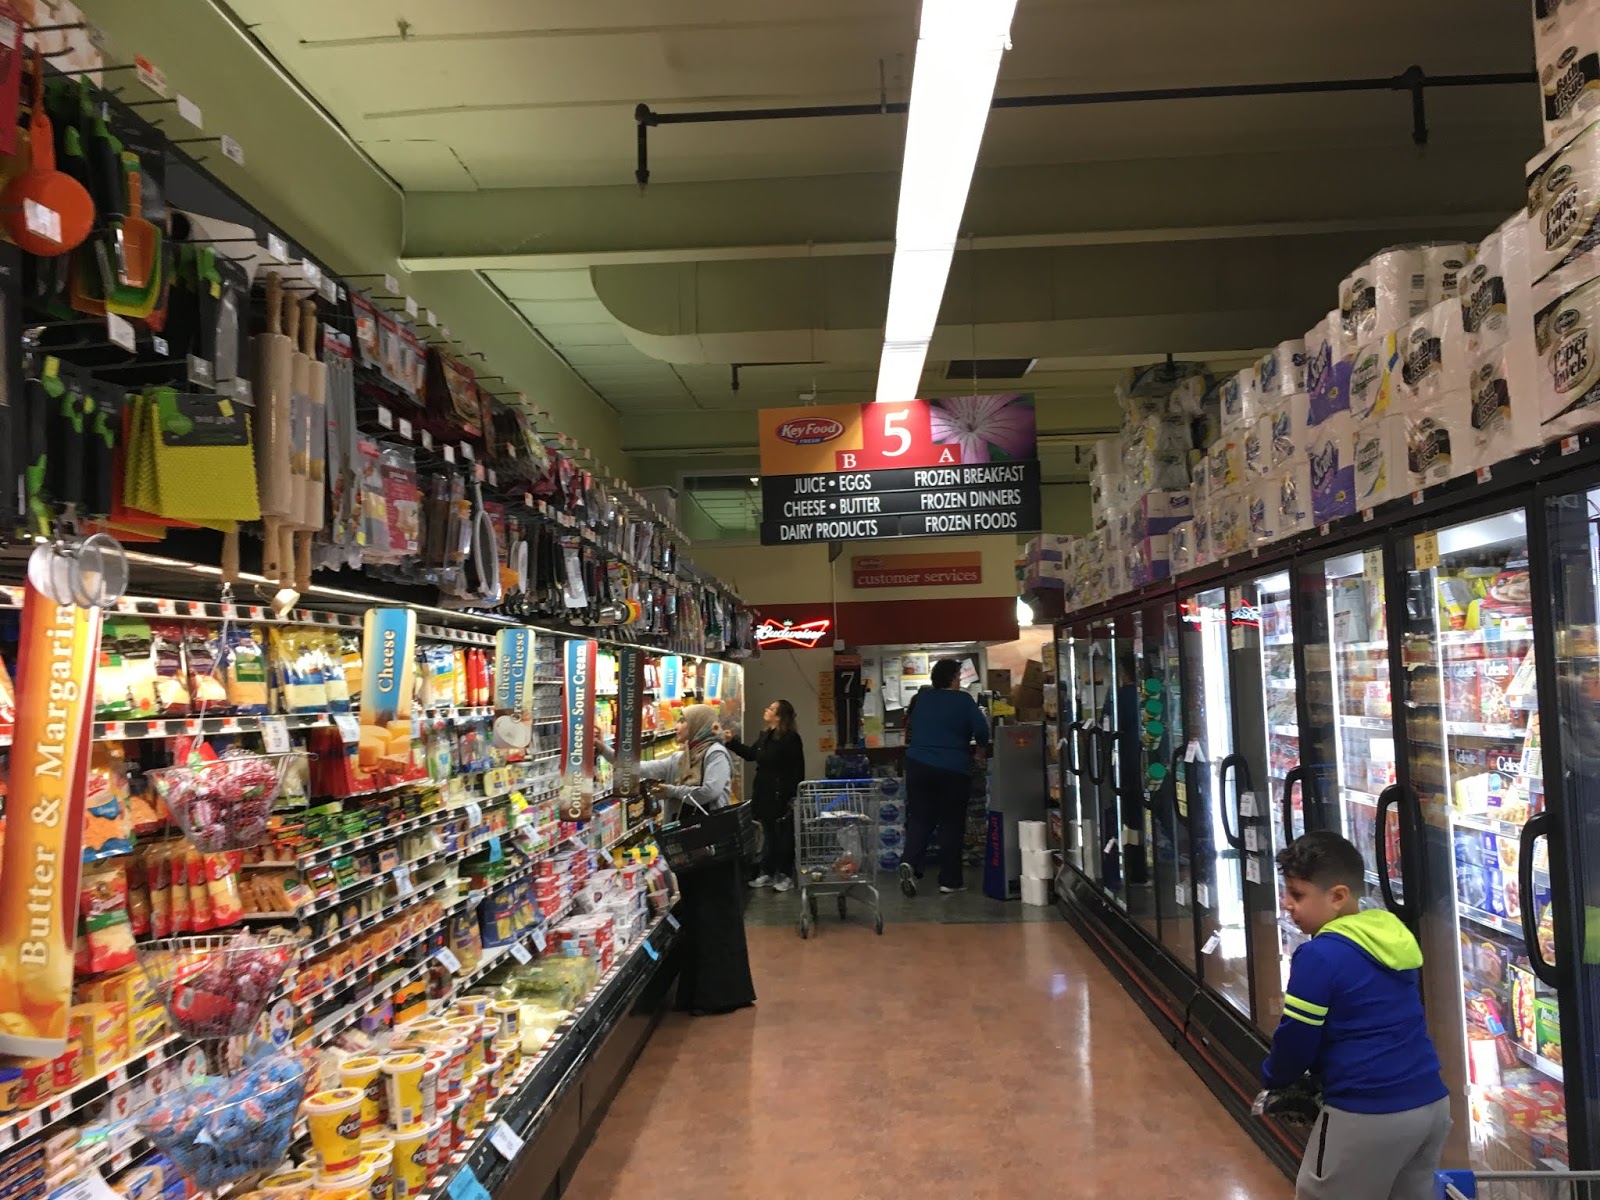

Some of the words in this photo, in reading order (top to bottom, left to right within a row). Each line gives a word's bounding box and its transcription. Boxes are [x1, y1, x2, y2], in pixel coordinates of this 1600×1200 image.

[1554, 333, 1588, 372] Paper
[781, 422, 803, 437] Key
[804, 422, 837, 436] Food
[881, 408, 912, 458] 5
[843, 453, 857, 469] B
[938, 448, 955, 463] A
[794, 477, 826, 494] JUICE
[839, 474, 872, 491] EGGS
[914, 470, 962, 488] FROZEN
[964, 465, 1026, 485] BREAKFAST
[783, 500, 827, 518] CHEESE
[839, 497, 881, 515] BUTTER
[920, 494, 968, 510] FROZEN
[970, 489, 1022, 507] DINNERS
[780, 524, 813, 541] DAIRY
[816, 520, 878, 538] PRODUCTS
[925, 516, 972, 532] FROZEN
[974, 512, 1018, 529] FOODS
[857, 573, 920, 585] customer
[924, 569, 977, 583] services
[754, 624, 827, 641] Budweiser
[377, 629, 396, 694] Cheese
[512, 632, 525, 678] Cheese
[572, 644, 587, 685] Cream
[625, 652, 637, 686] Cream
[35, 602, 78, 778] Margarin
[498, 655, 511, 701] Cheese
[841, 671, 855, 693] 7
[510, 680, 524, 724] Cream
[571, 687, 585, 716] Sour
[624, 687, 636, 711] Sour
[569, 723, 584, 766] Cheese
[621, 717, 634, 752] Cheese
[619, 756, 633, 795] Cottage
[1497, 756, 1522, 772] Celes
[568, 771, 585, 819] Cottage
[31, 797, 61, 828] &
[20, 844, 56, 967] Butter
